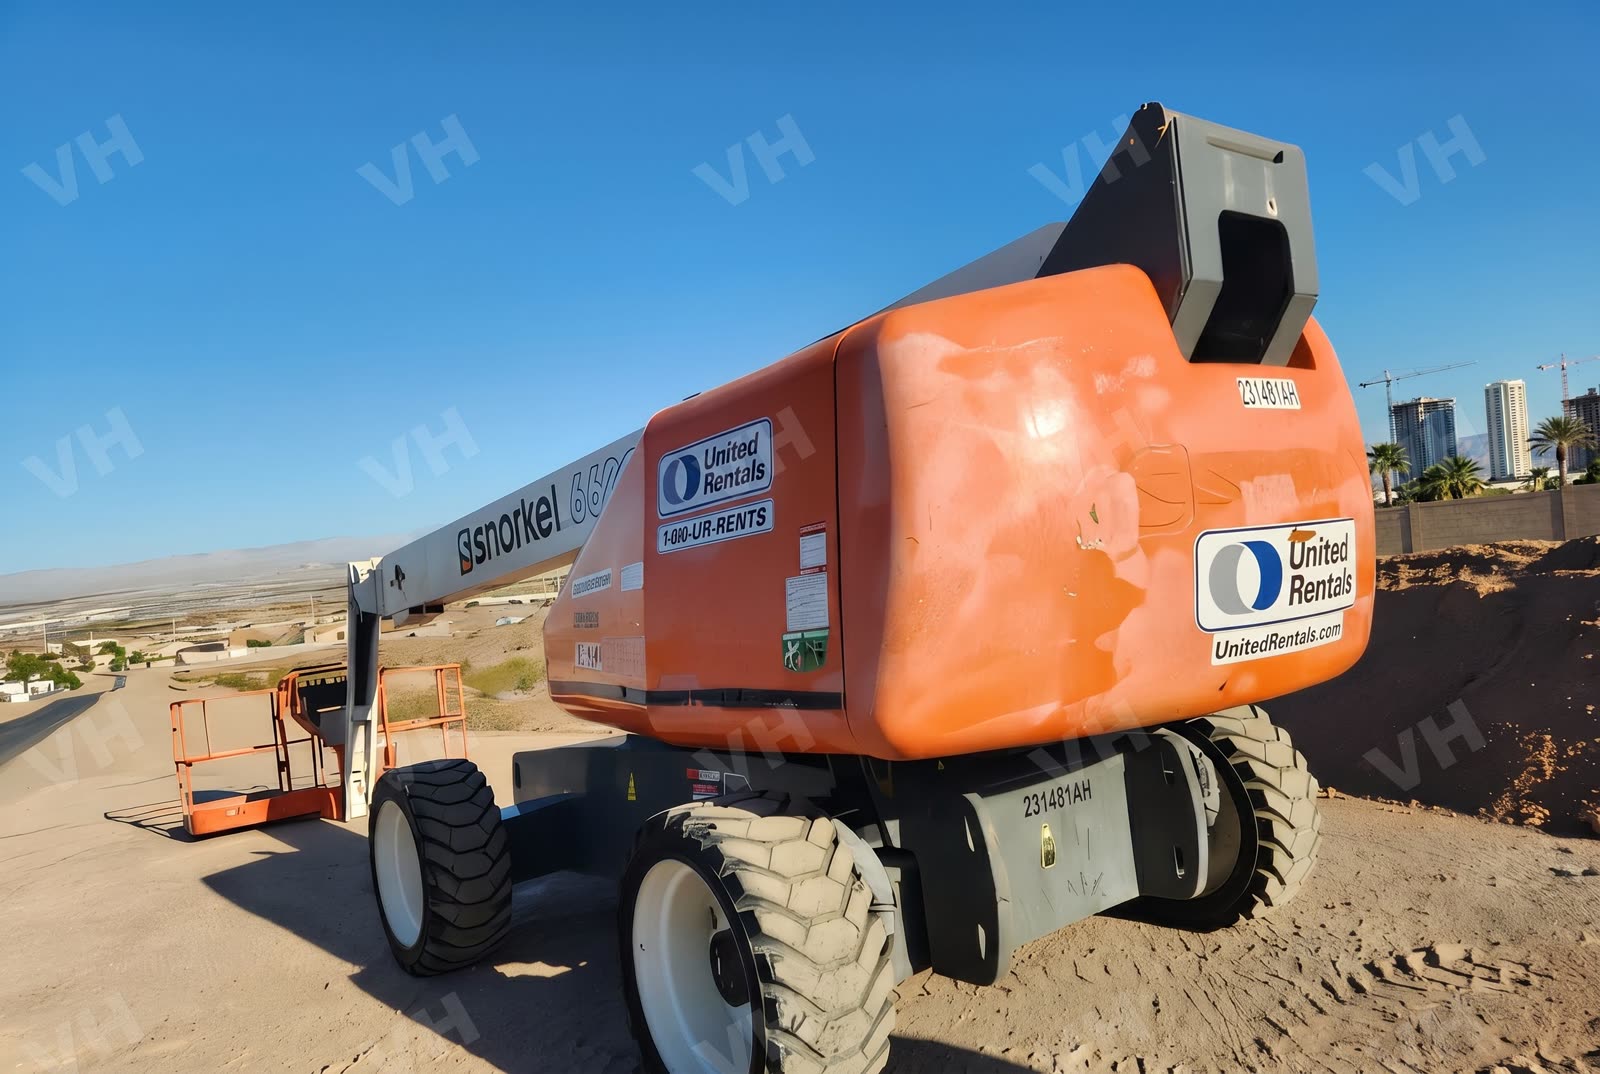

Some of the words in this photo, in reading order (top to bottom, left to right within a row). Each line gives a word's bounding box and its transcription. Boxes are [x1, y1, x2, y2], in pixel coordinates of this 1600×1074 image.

[1238, 379, 1299, 406] 231481AH
[704, 431, 760, 470] United
[703, 458, 765, 496] Rentals
[473, 483, 562, 565] snorkel
[1289, 532, 1349, 570] United
[1288, 567, 1353, 606] Rentals
[1215, 623, 1341, 660] UnitedRentals.com
[1023, 778, 1092, 818] 231481AH
